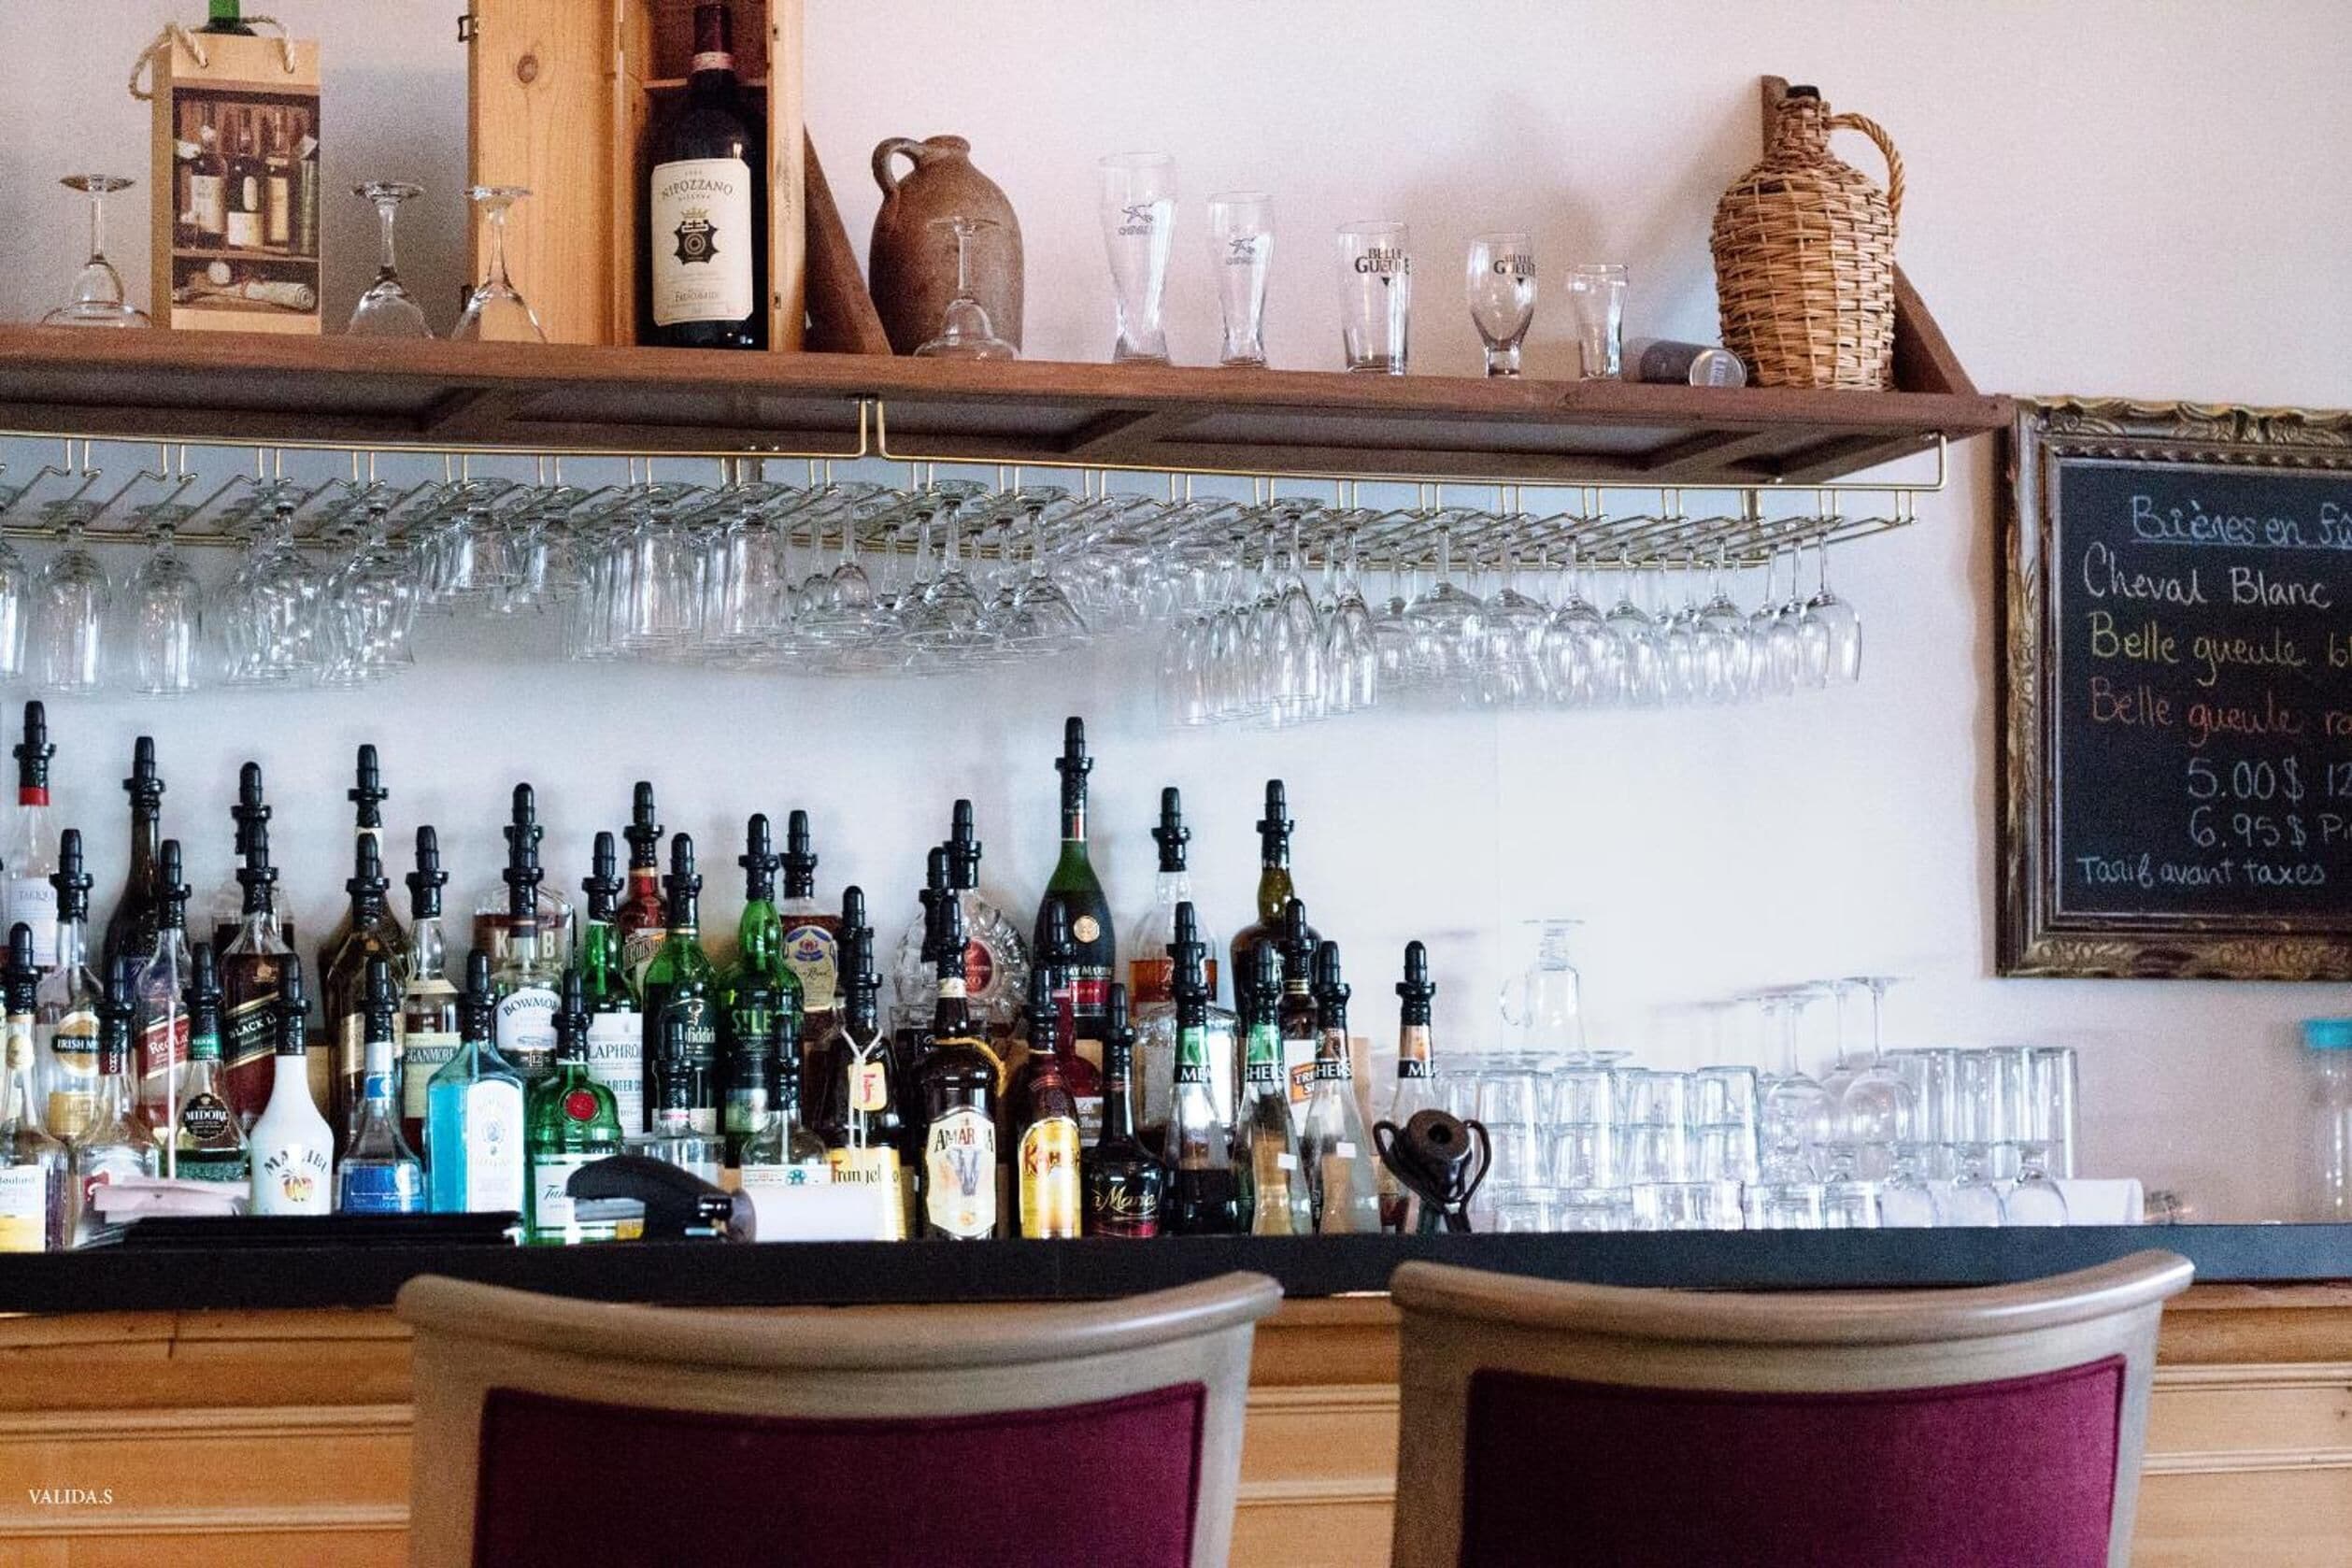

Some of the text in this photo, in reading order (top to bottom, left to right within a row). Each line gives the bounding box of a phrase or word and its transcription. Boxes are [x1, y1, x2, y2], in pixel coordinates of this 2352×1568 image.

[661, 178, 734, 201] NIPOZZANO
[2265, 517, 2307, 546] en
[2084, 541, 2331, 608] Cheval Blanc
[2088, 611, 2180, 663] Belle
[2194, 626, 2306, 687] gueule
[2090, 676, 2174, 727] Belle
[2188, 688, 2302, 748] gueule
[2075, 853, 2326, 888] Tarif avant taxes
[57, 1038, 84, 1050] IRISH
[934, 1128, 993, 1153] AMARA
